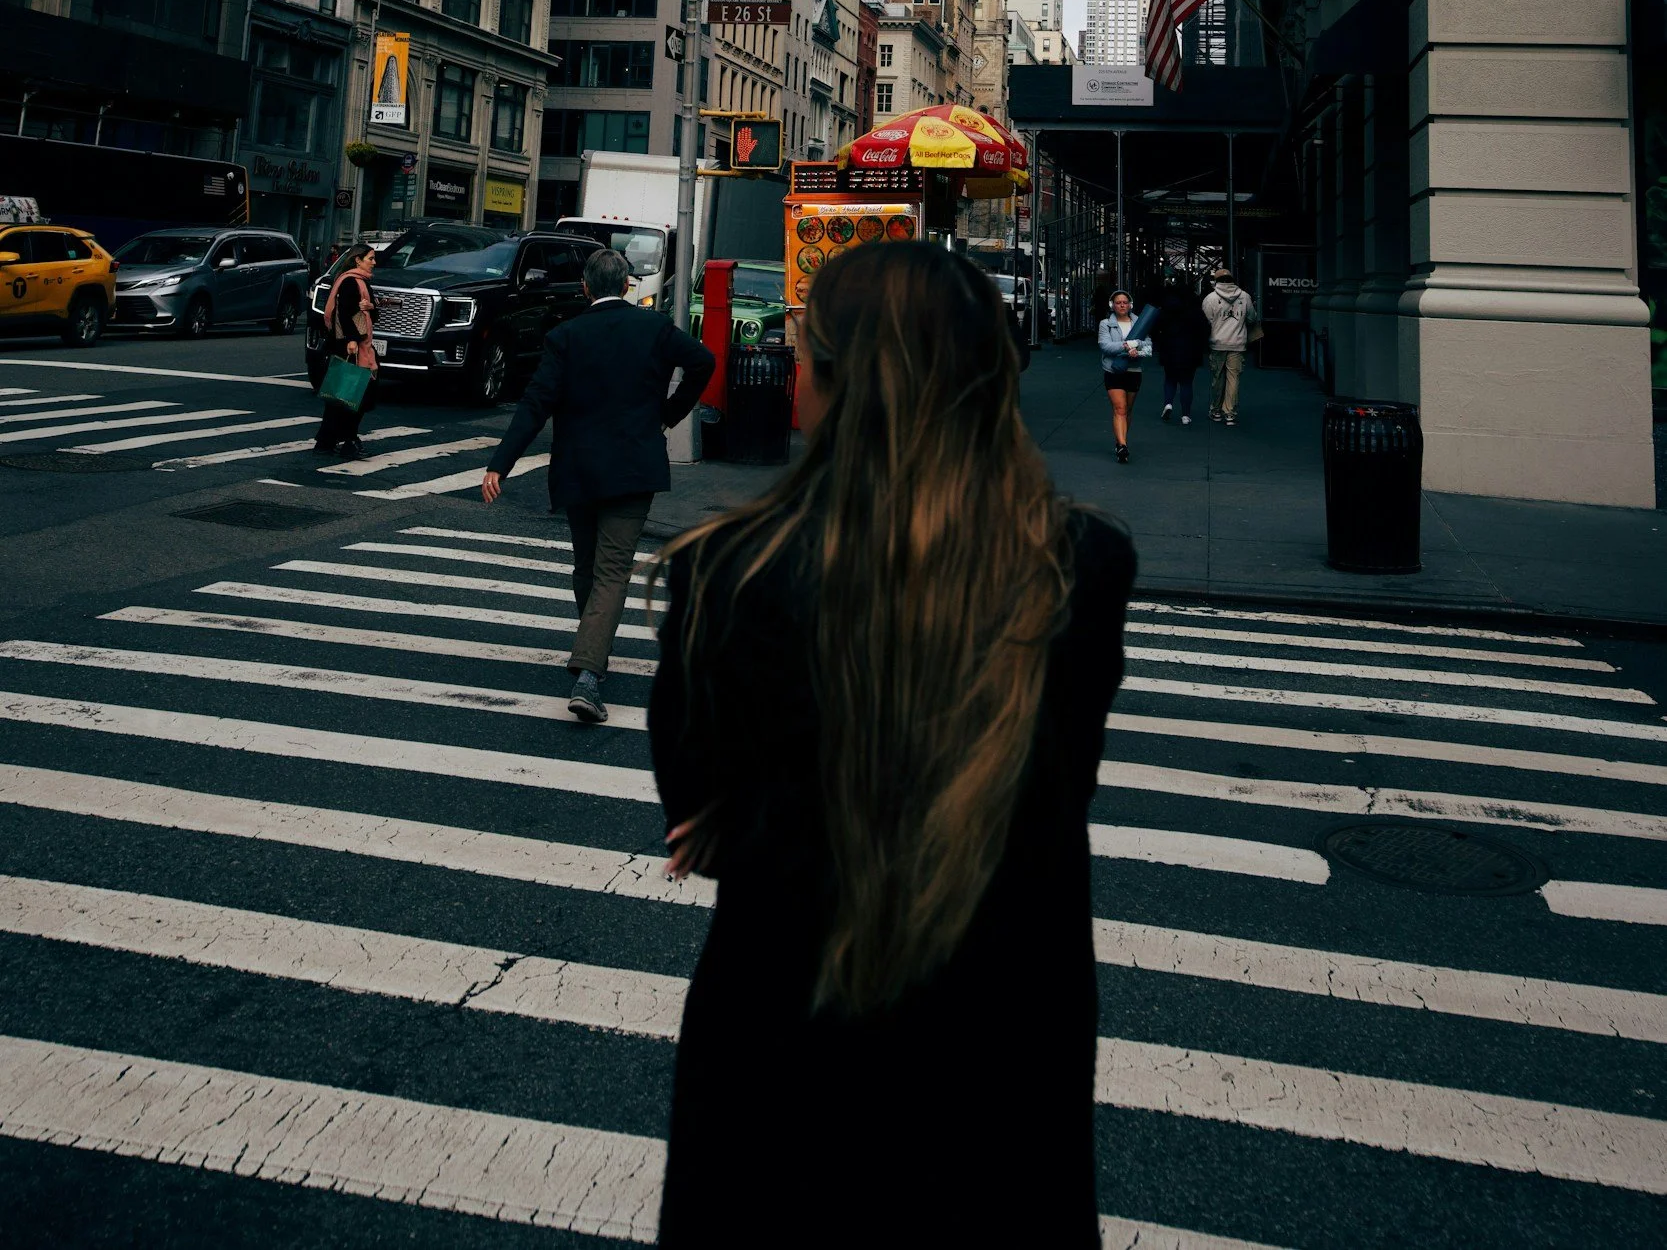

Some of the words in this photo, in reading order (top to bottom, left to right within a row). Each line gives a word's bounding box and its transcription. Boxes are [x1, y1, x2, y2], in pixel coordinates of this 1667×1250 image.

[721, 5, 729, 22] E
[734, 5, 751, 22] 26
[757, 6, 772, 22] St
[862, 148, 899, 162] Coca-Cola
[953, 152, 971, 160] Dogs
